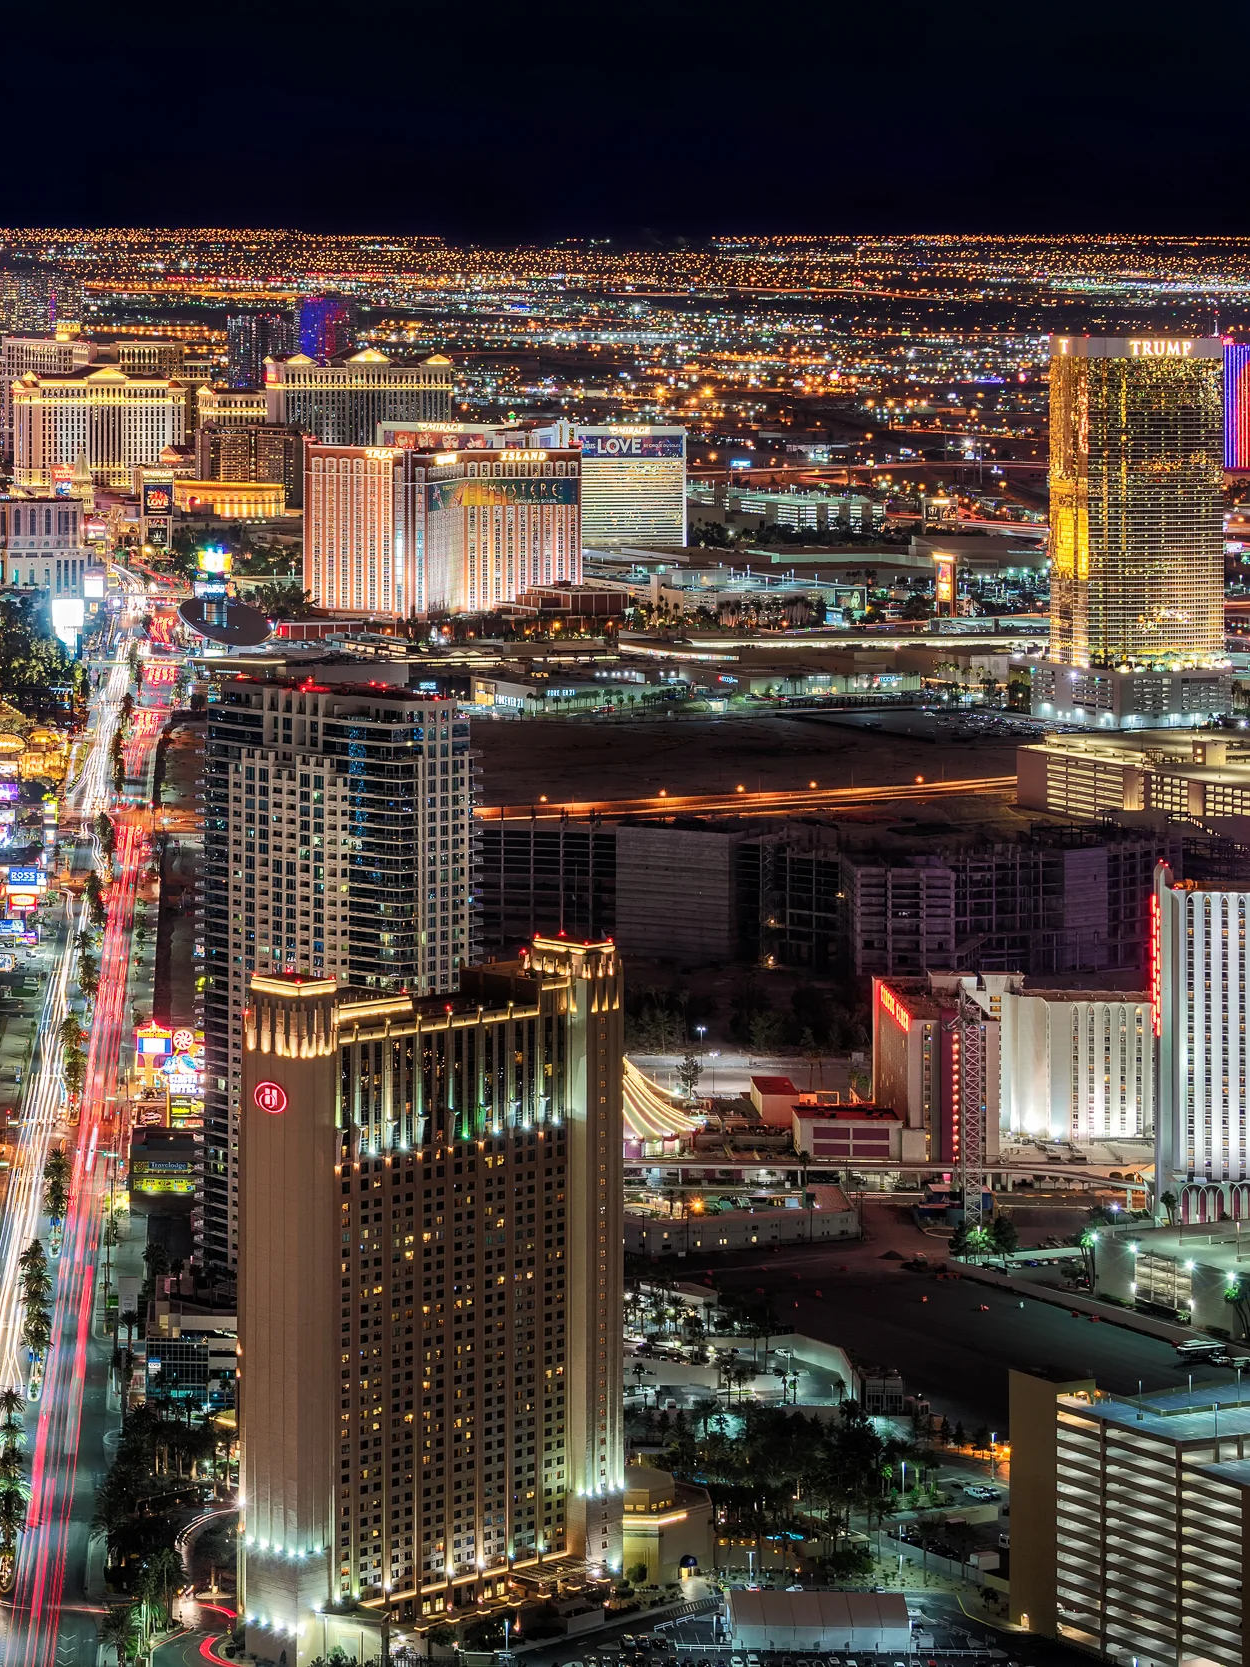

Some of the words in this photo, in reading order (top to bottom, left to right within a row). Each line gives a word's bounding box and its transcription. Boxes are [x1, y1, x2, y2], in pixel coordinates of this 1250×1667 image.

[1130, 341, 1192, 356] TRUMP
[598, 439, 642, 454] LOVE
[501, 452, 547, 461] ISLAND
[147, 499, 169, 507] LOVE
[495, 694, 516, 707] FOREVER
[517, 698, 524, 708] 21
[151, 1162, 186, 1170] Travelodge
